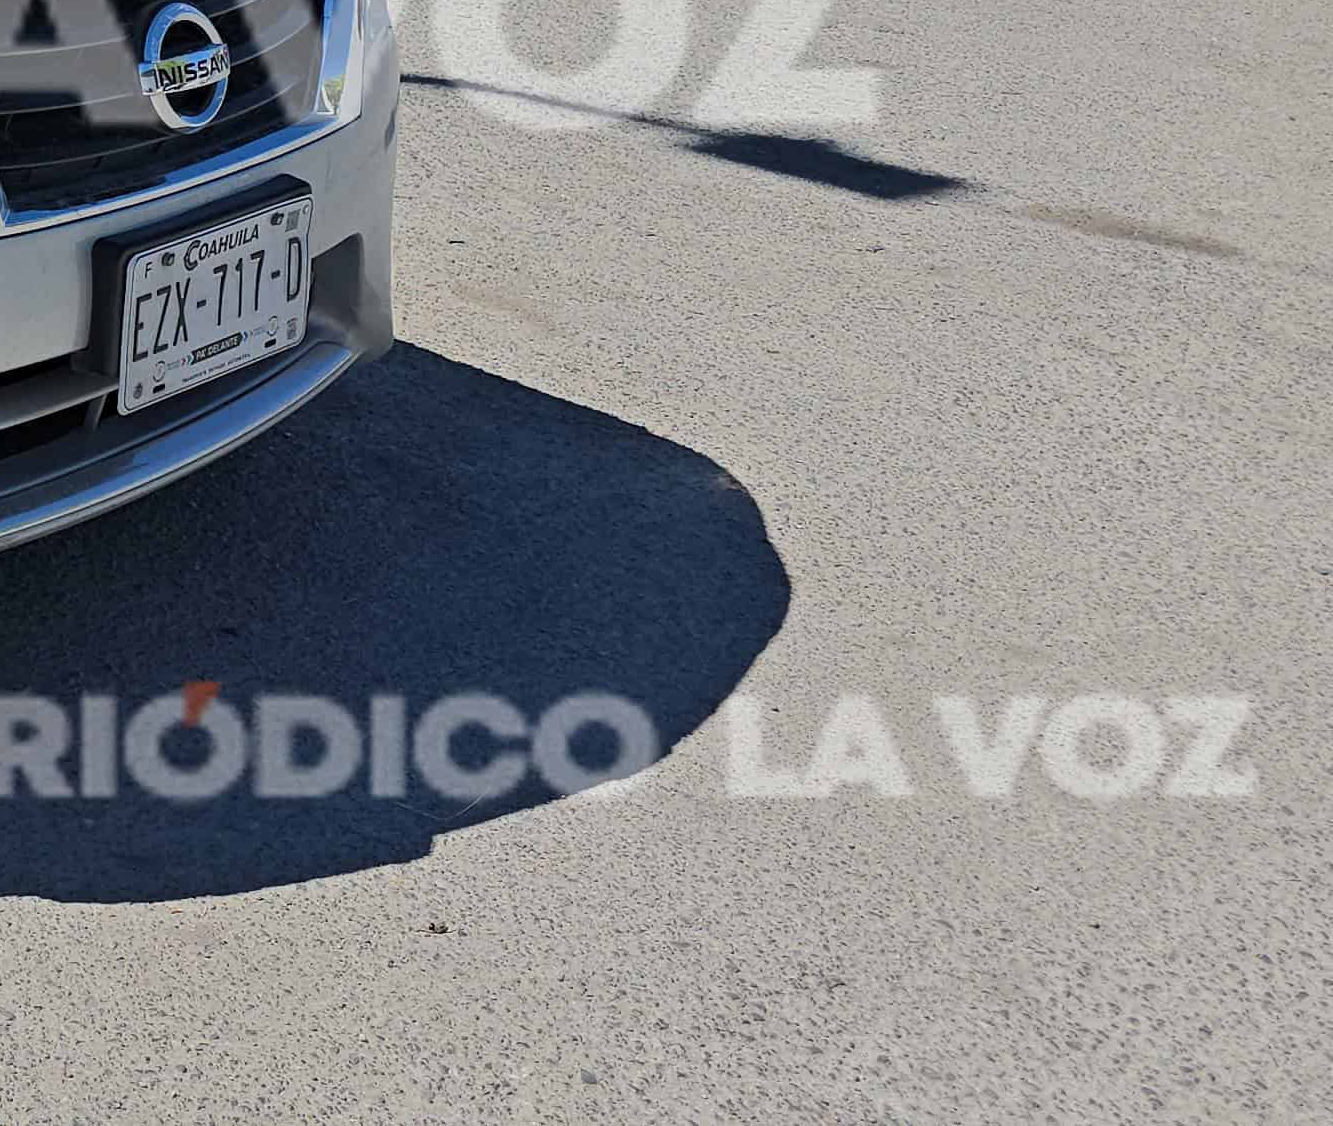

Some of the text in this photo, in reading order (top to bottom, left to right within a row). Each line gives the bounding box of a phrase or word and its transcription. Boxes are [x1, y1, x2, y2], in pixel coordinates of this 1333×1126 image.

[158, 52, 230, 90] NISSAN
[183, 224, 259, 271] COAHUILA
[145, 261, 153, 279] F
[132, 237, 303, 362] EZX-717-D
